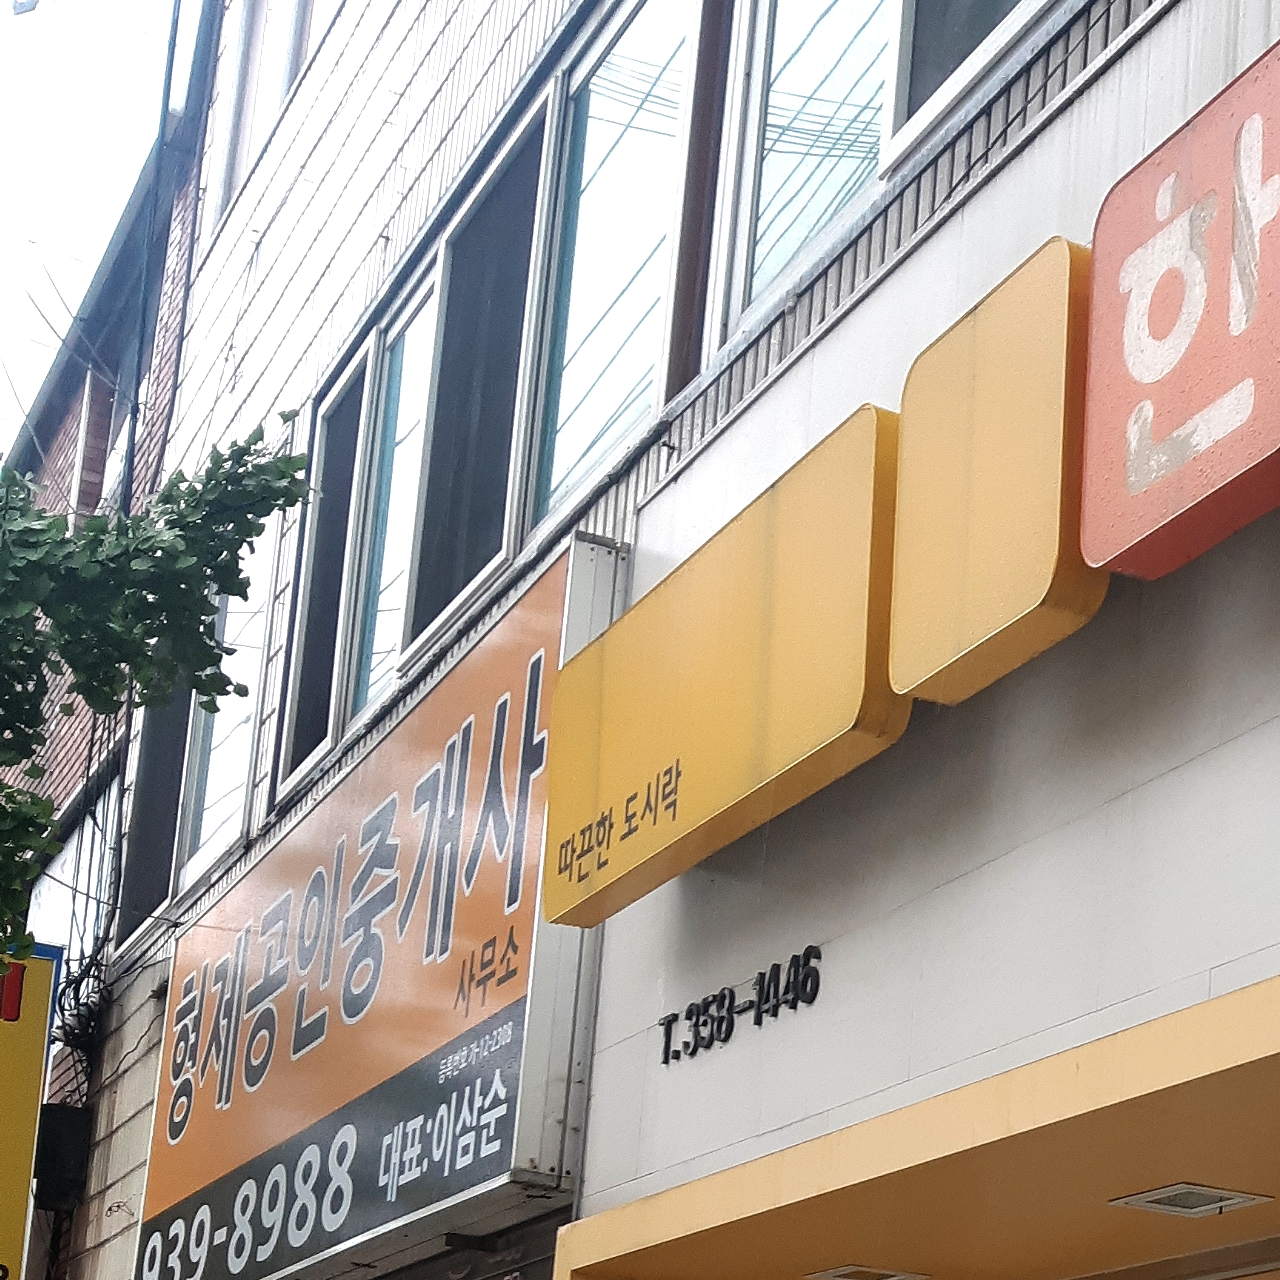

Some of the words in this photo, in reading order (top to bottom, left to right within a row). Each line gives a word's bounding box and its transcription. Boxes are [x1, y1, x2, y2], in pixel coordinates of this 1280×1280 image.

[558, 808, 614, 884] 따끈한
[619, 757, 682, 842] 도시락
[166, 648, 549, 1146] 형제공인중개사
[455, 925, 519, 1017] 사무소
[377, 1068, 508, 1203] 대표:이삼순
